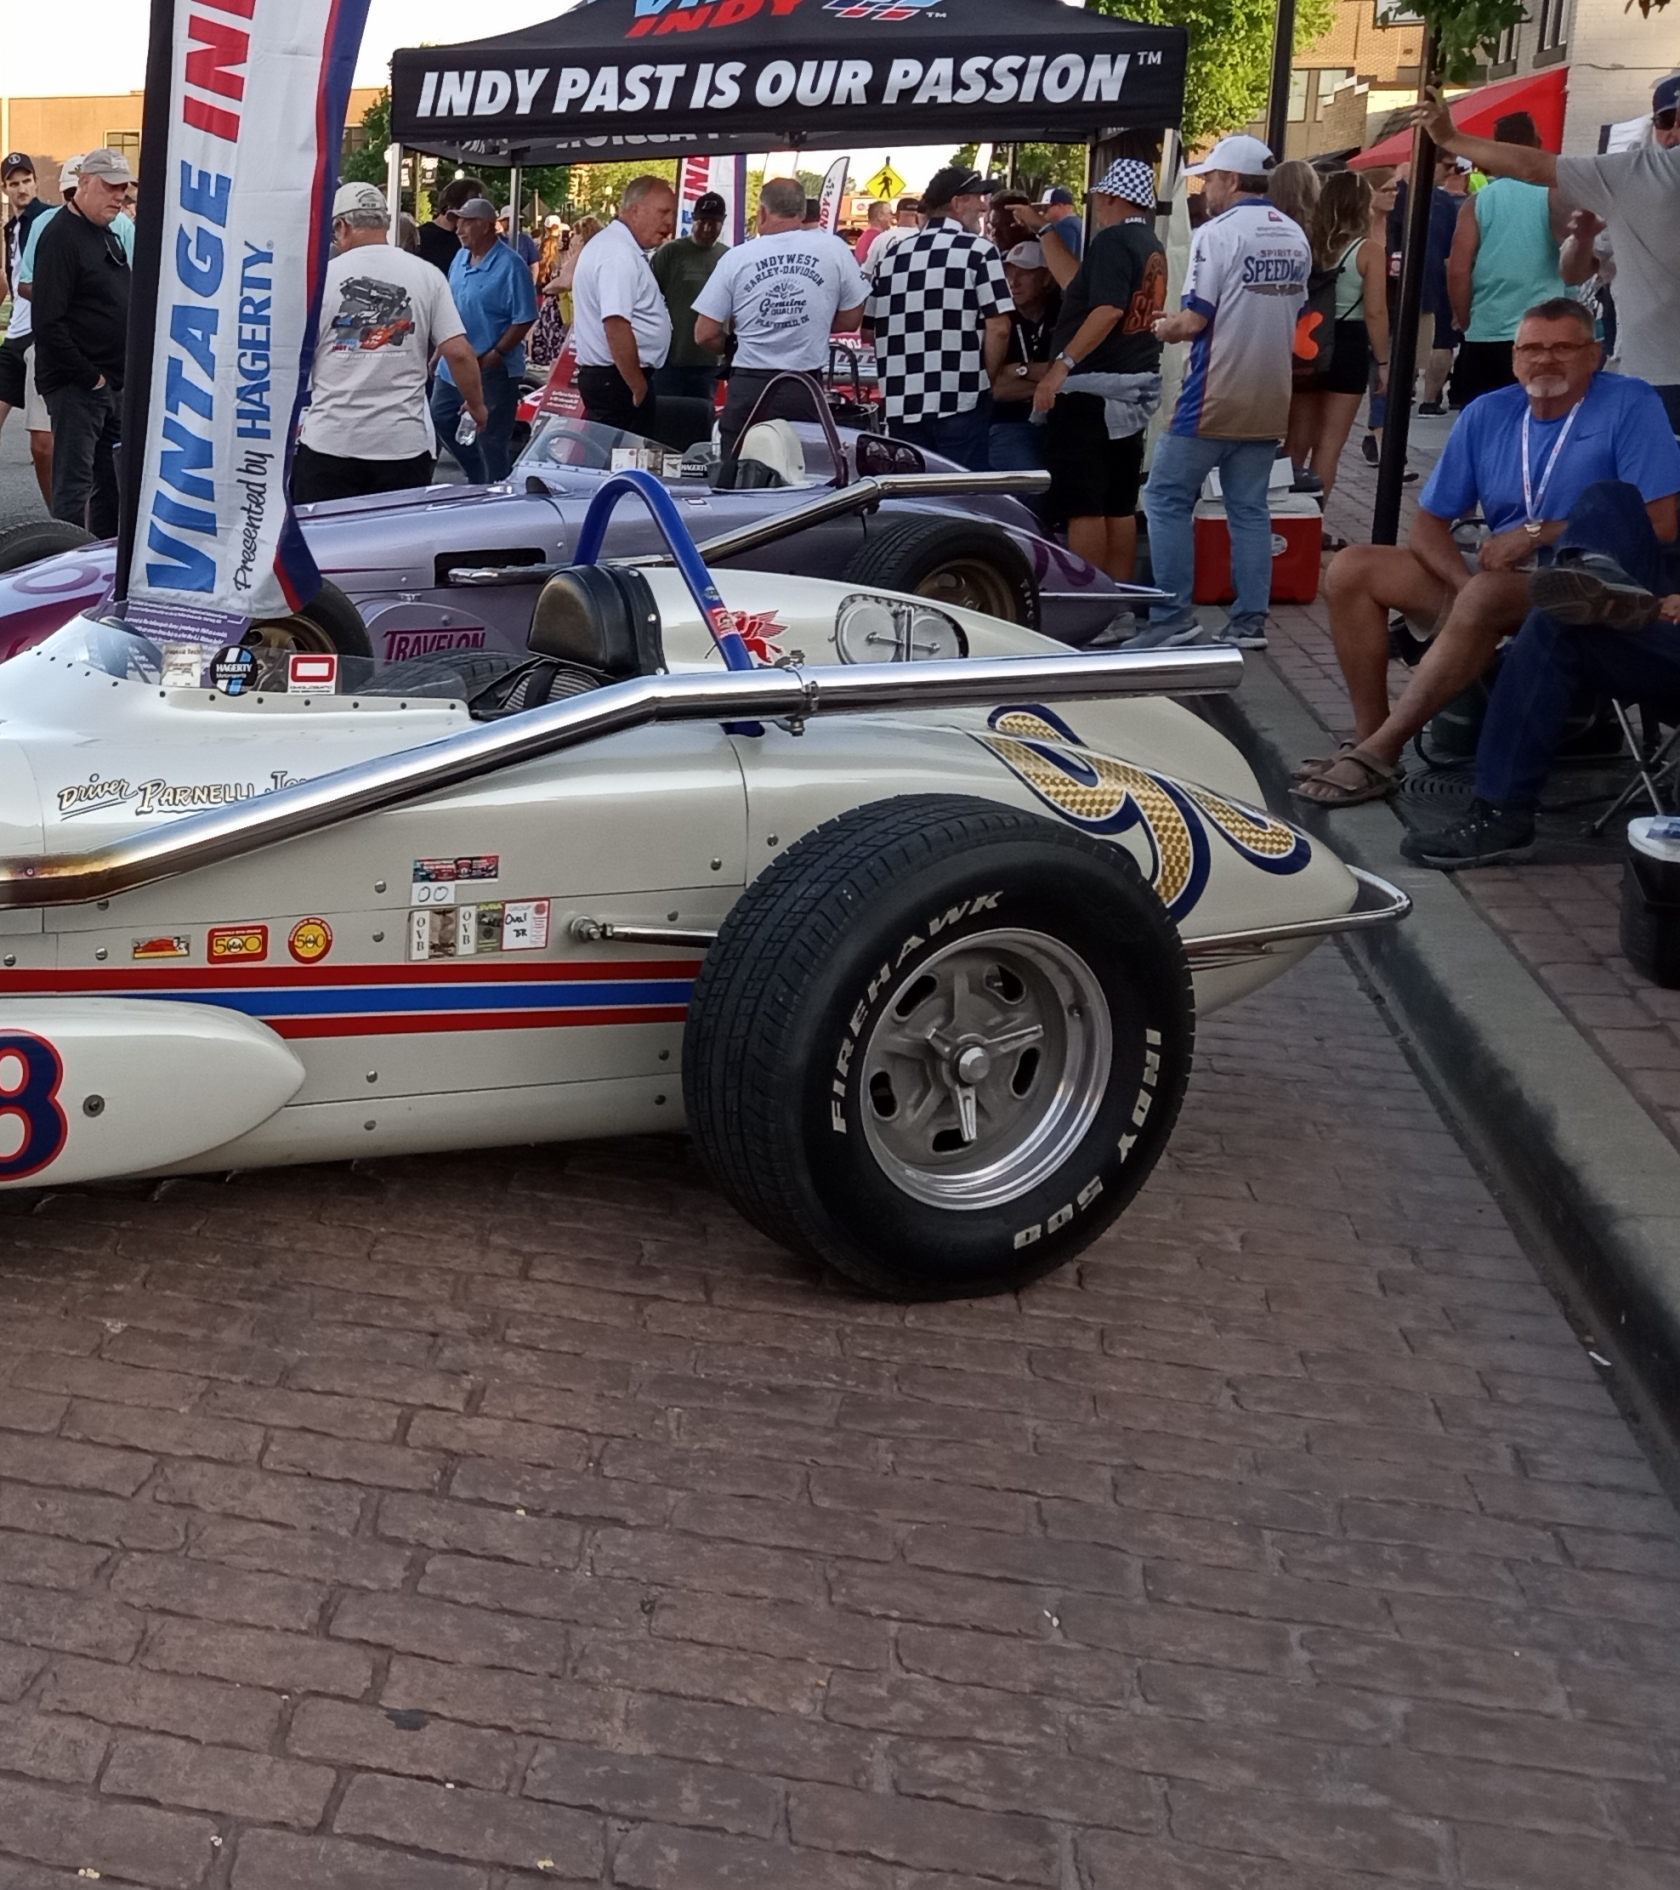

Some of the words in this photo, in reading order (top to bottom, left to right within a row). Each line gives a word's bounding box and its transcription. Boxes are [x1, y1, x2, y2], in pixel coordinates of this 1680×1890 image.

[183, 0, 256, 143] IN
[416, 68, 550, 118] INDY
[552, 64, 686, 115] PAST
[689, 61, 747, 109] IS
[755, 58, 874, 107] OUR
[882, 54, 1131, 104] PASSION
[755, 253, 820, 273] INDYWEST
[1260, 249, 1292, 258] SPIRIT
[743, 265, 825, 293] HARLEY-DAVIDSON
[759, 298, 807, 317] Genuine
[770, 307, 804, 316] QUALITY
[146, 160, 232, 594] VINTAGE
[236, 450, 275, 479] by
[234, 479, 268, 592] Presented
[216, 663, 253, 672] HAGERTY
[57, 773, 137, 812] Driver
[135, 779, 255, 816] PARNELLI
[830, 890, 1004, 1135] FIREHAWK
[1117, 1027, 1162, 1164] INDY
[1013, 1175, 1104, 1250] 500
